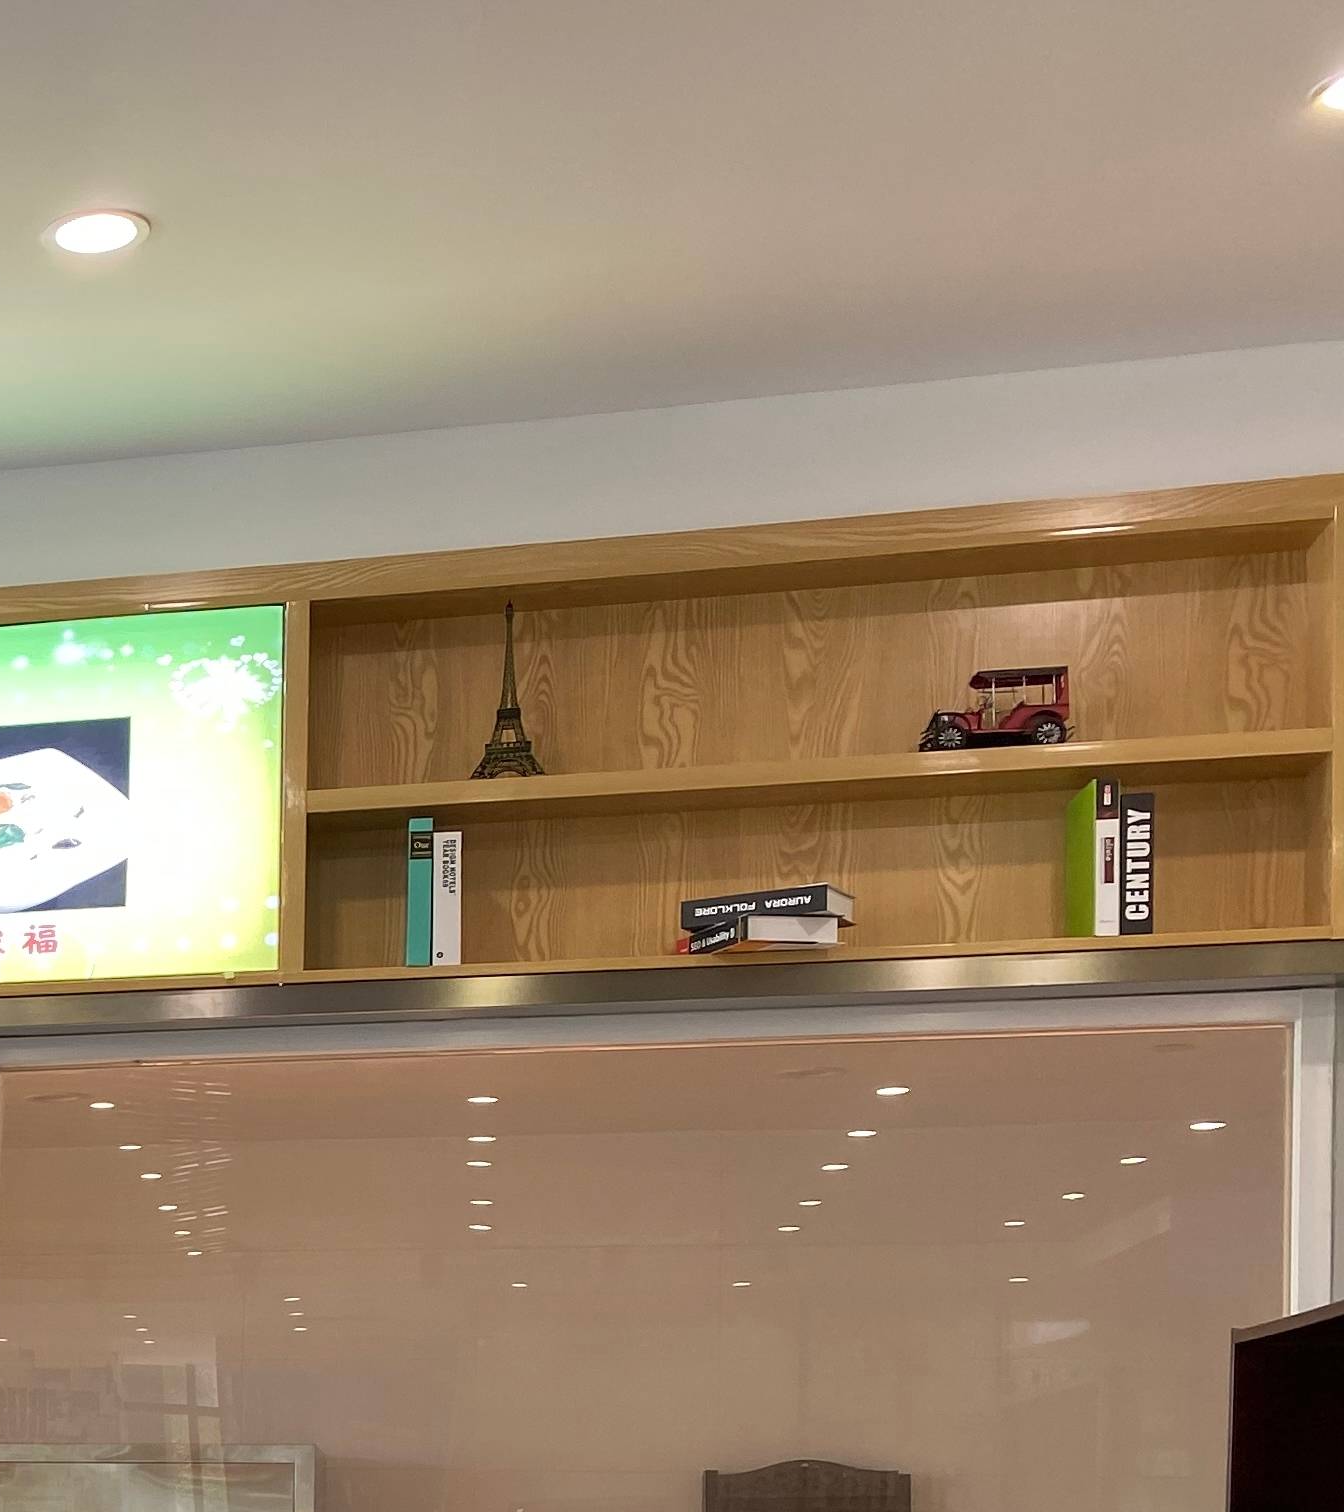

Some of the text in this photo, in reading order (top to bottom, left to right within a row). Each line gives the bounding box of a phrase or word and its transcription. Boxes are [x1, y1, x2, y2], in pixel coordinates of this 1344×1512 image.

[1125, 809, 1151, 920] CENTURY
[694, 895, 813, 917] AURORA FOLKLORE
